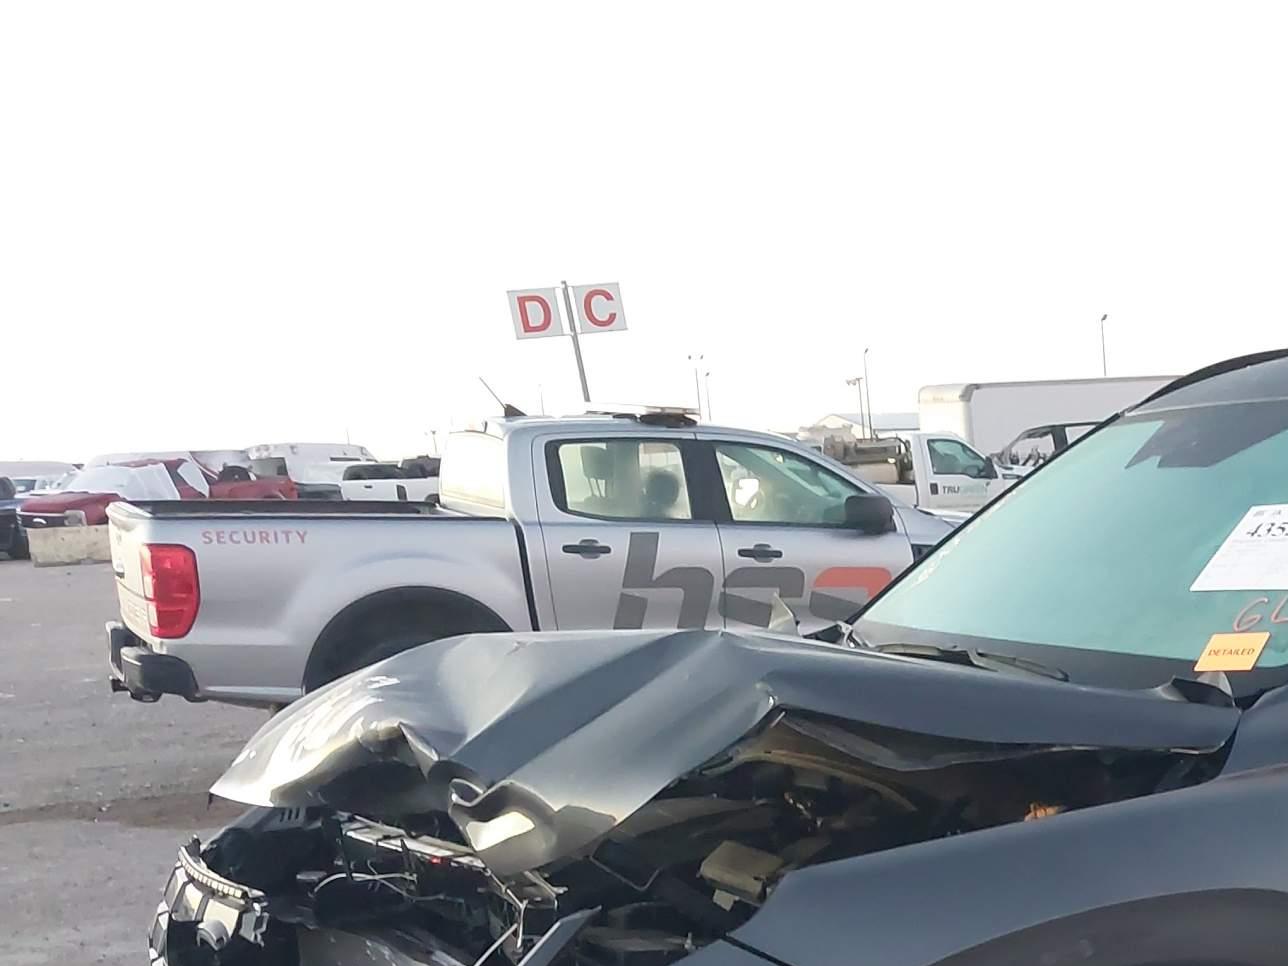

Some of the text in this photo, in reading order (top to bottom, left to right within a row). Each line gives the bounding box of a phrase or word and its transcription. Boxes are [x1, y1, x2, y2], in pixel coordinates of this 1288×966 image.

[516, 295, 552, 334] D
[583, 288, 617, 327] C
[201, 530, 308, 544] SECURITY
[1207, 648, 1256, 657] DETAILED
